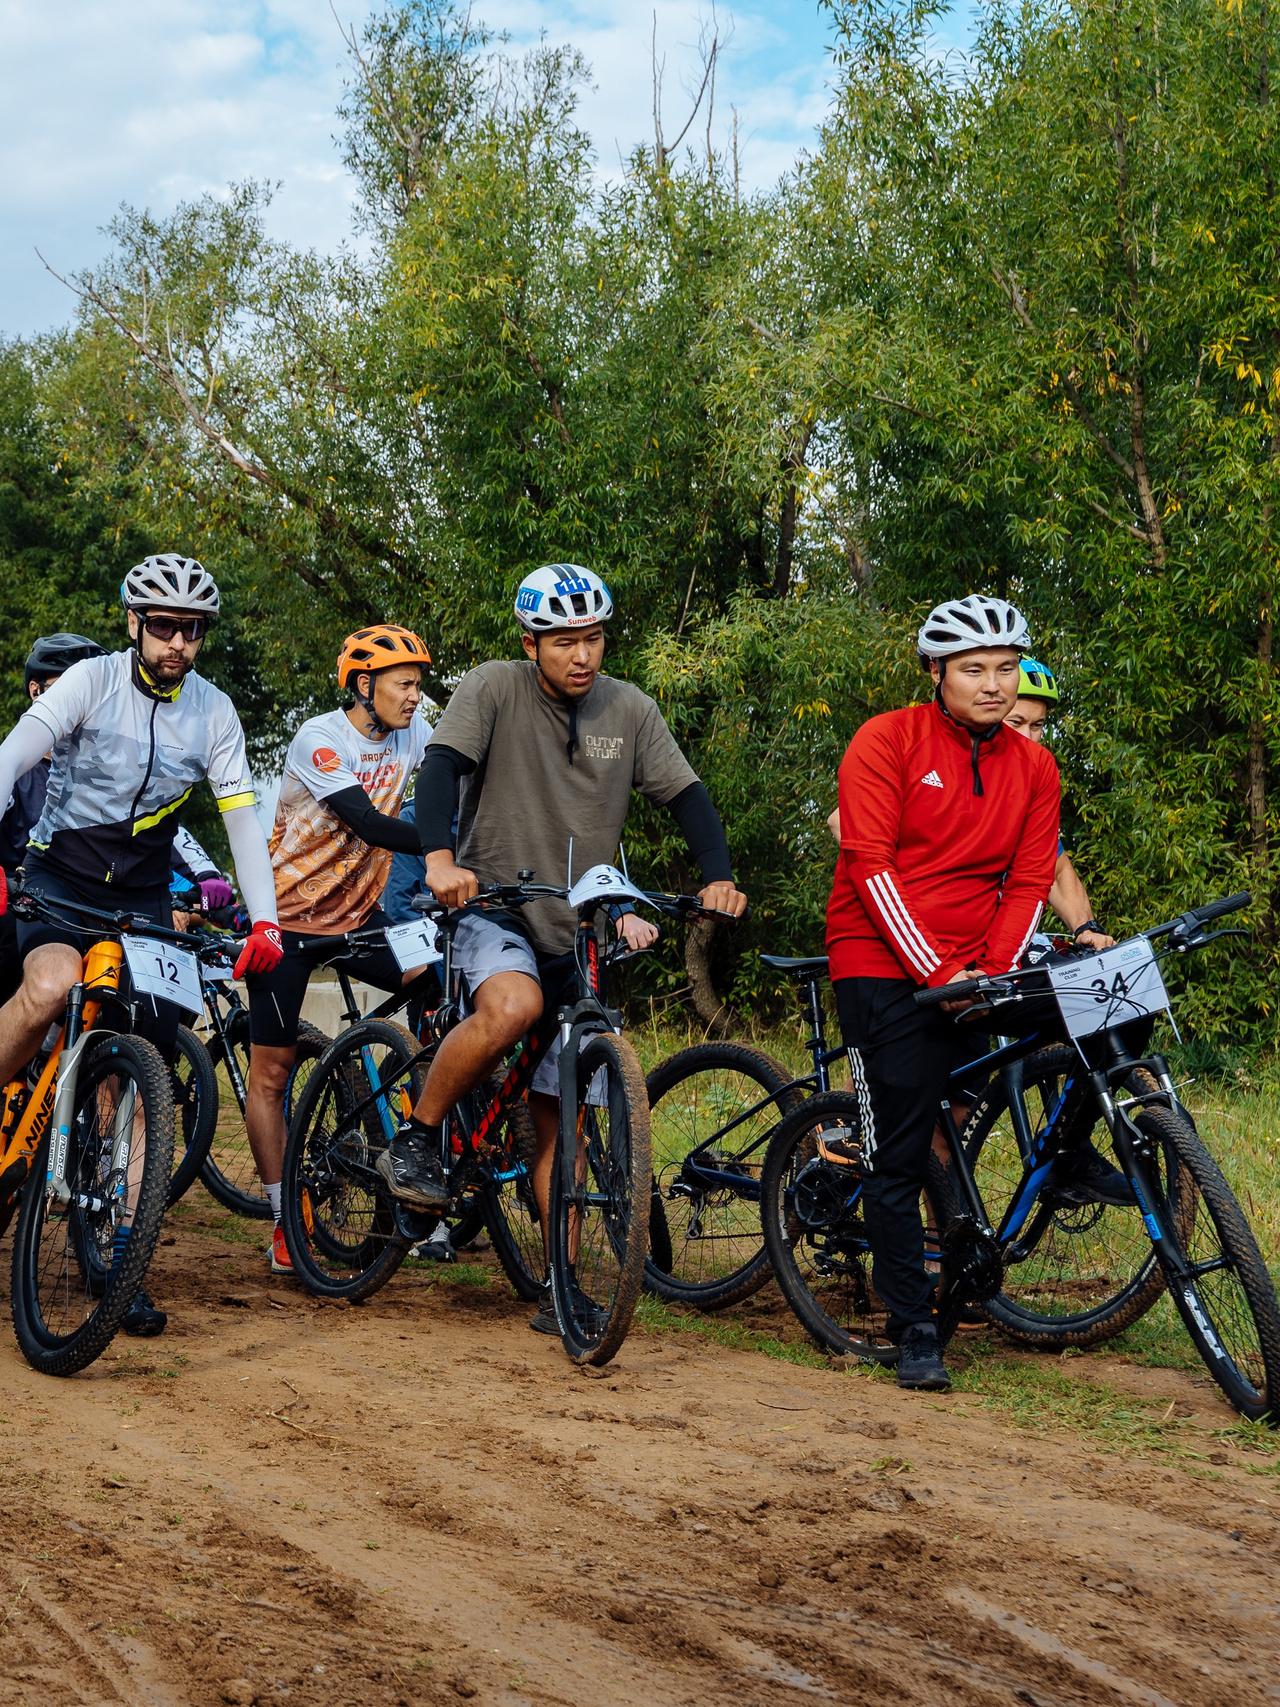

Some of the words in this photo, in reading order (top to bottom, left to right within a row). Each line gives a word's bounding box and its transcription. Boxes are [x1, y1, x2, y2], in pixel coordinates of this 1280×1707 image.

[560, 578, 586, 592] 111
[520, 591, 535, 607] 111
[567, 615, 597, 626] Sunweb
[921, 777, 943, 789] adidas
[596, 874, 626, 886] 31
[155, 957, 180, 985] 12
[588, 940, 599, 994] GIANT
[1058, 967, 1081, 977] TRAINING
[1091, 971, 1128, 1003] 34
[25, 1066, 59, 1150] NINET
[960, 1101, 989, 1150] AXXIS
